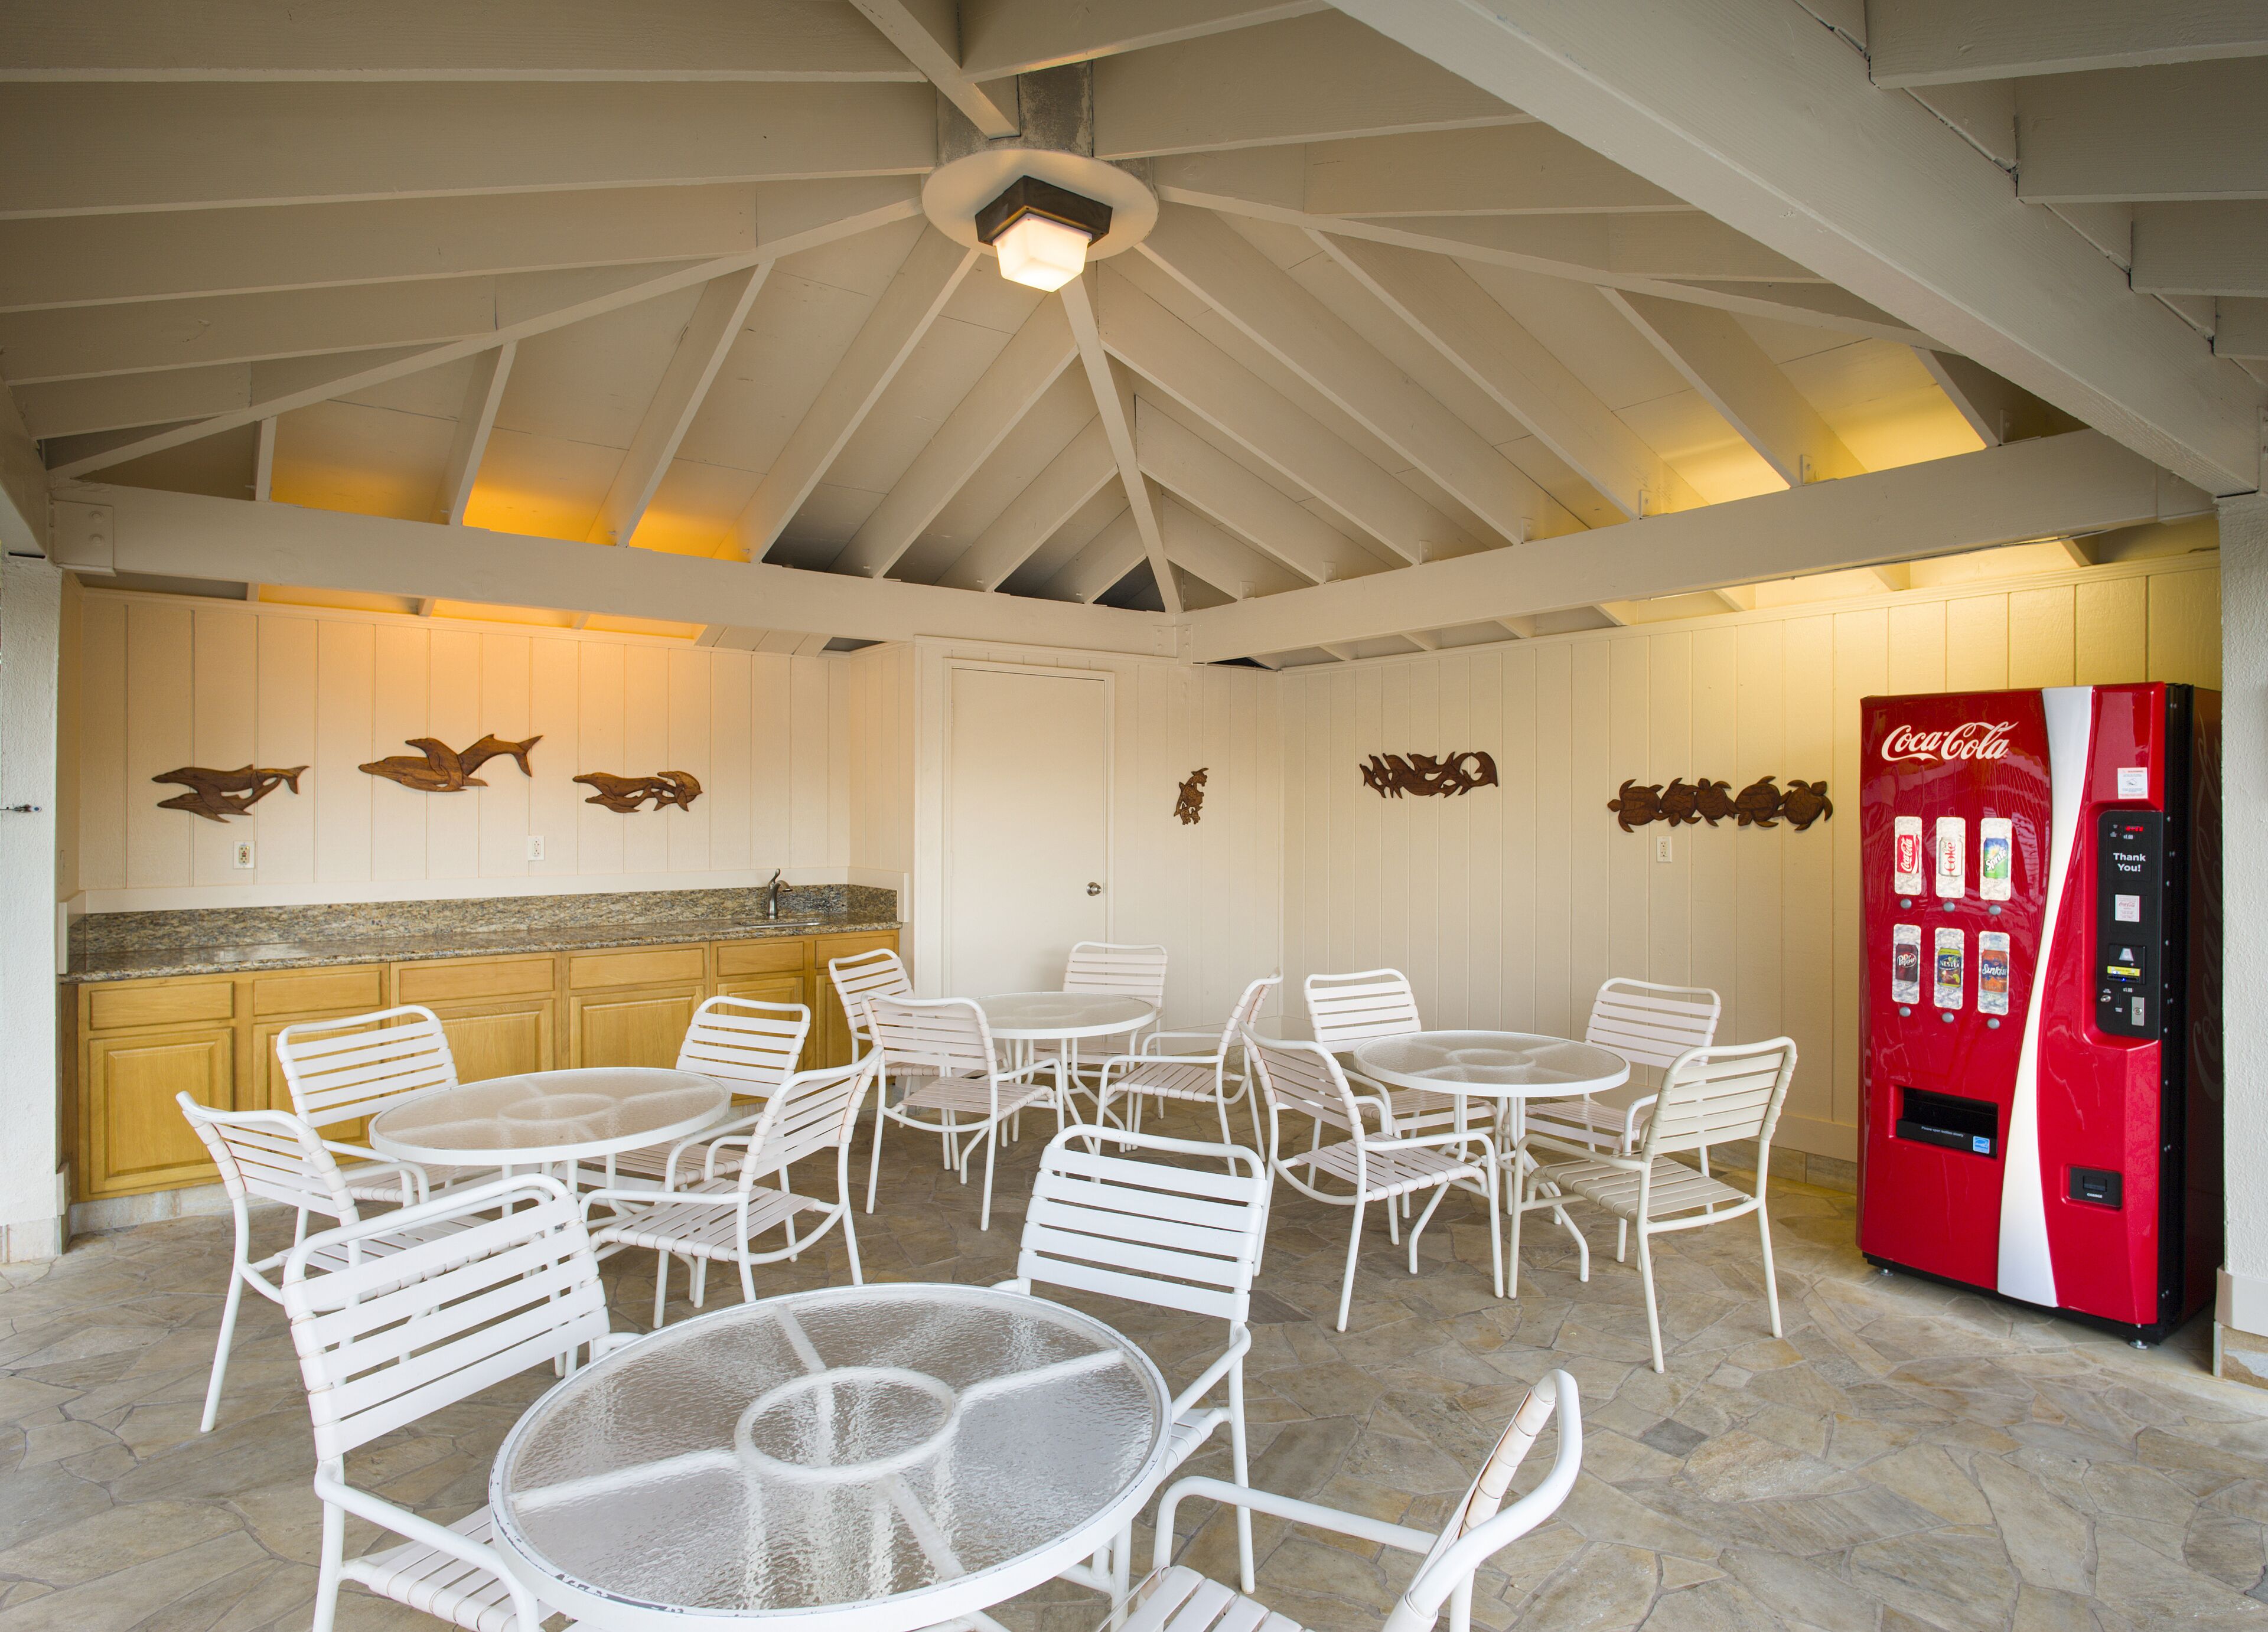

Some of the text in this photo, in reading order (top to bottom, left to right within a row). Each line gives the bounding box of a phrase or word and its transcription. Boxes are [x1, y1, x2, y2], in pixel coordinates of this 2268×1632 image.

[1881, 721, 2019, 761] Coca-Cola
[1901, 837, 1913, 872] Coca-Cola
[1944, 842, 1956, 871] Coke
[1985, 847, 2007, 871] Sprite
[2113, 853, 2146, 861] Thank
[2117, 863, 2141, 872] You!
[1898, 955, 1915, 965] Pepper
